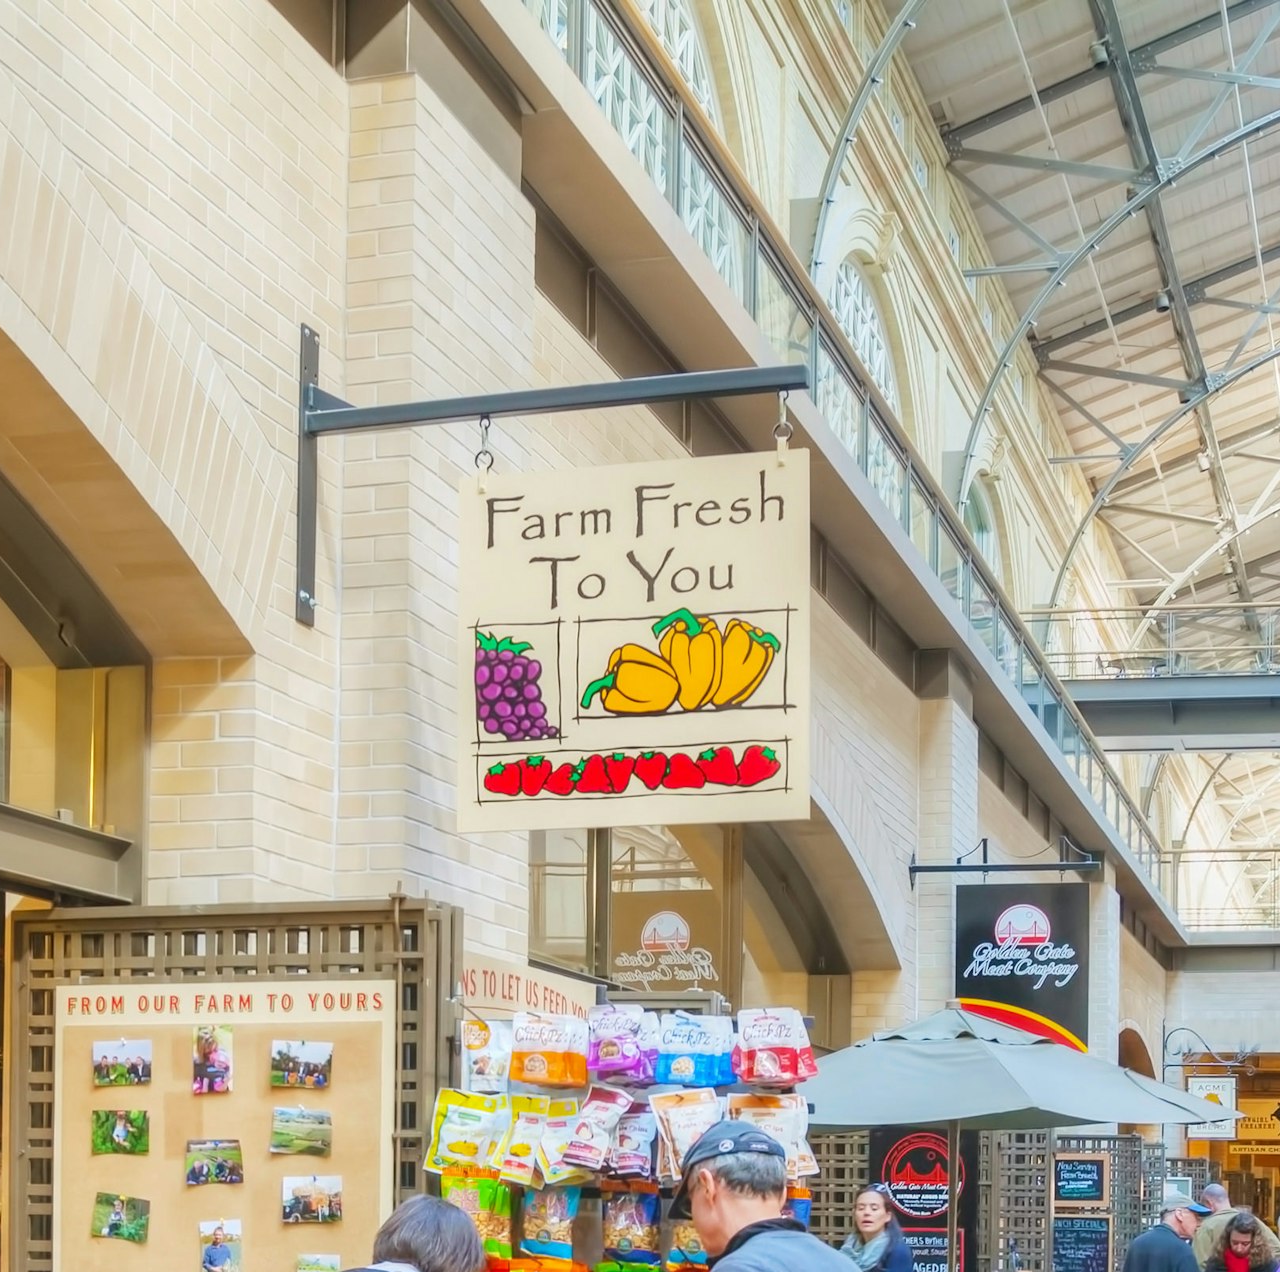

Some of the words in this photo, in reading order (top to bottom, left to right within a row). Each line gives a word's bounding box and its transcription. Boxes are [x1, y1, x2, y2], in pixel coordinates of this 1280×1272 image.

[486, 495, 611, 549] Farm
[635, 470, 784, 538] Fresh
[529, 556, 607, 610] To
[626, 547, 734, 602] You
[973, 936, 1031, 960] Golden
[1034, 941, 1075, 961] Gate
[483, 970, 496, 996] TO
[501, 973, 521, 1000] LET
[526, 979, 538, 1008] US
[963, 958, 1014, 978] Meat
[1014, 958, 1079, 990] Company
[67, 995, 125, 1015] FROM
[138, 995, 180, 1014] OUR
[194, 993, 253, 1012] FARM
[267, 993, 293, 1011] TO
[308, 992, 384, 1011] YOURS
[1074, 1220, 1107, 1229] SPECIALS
